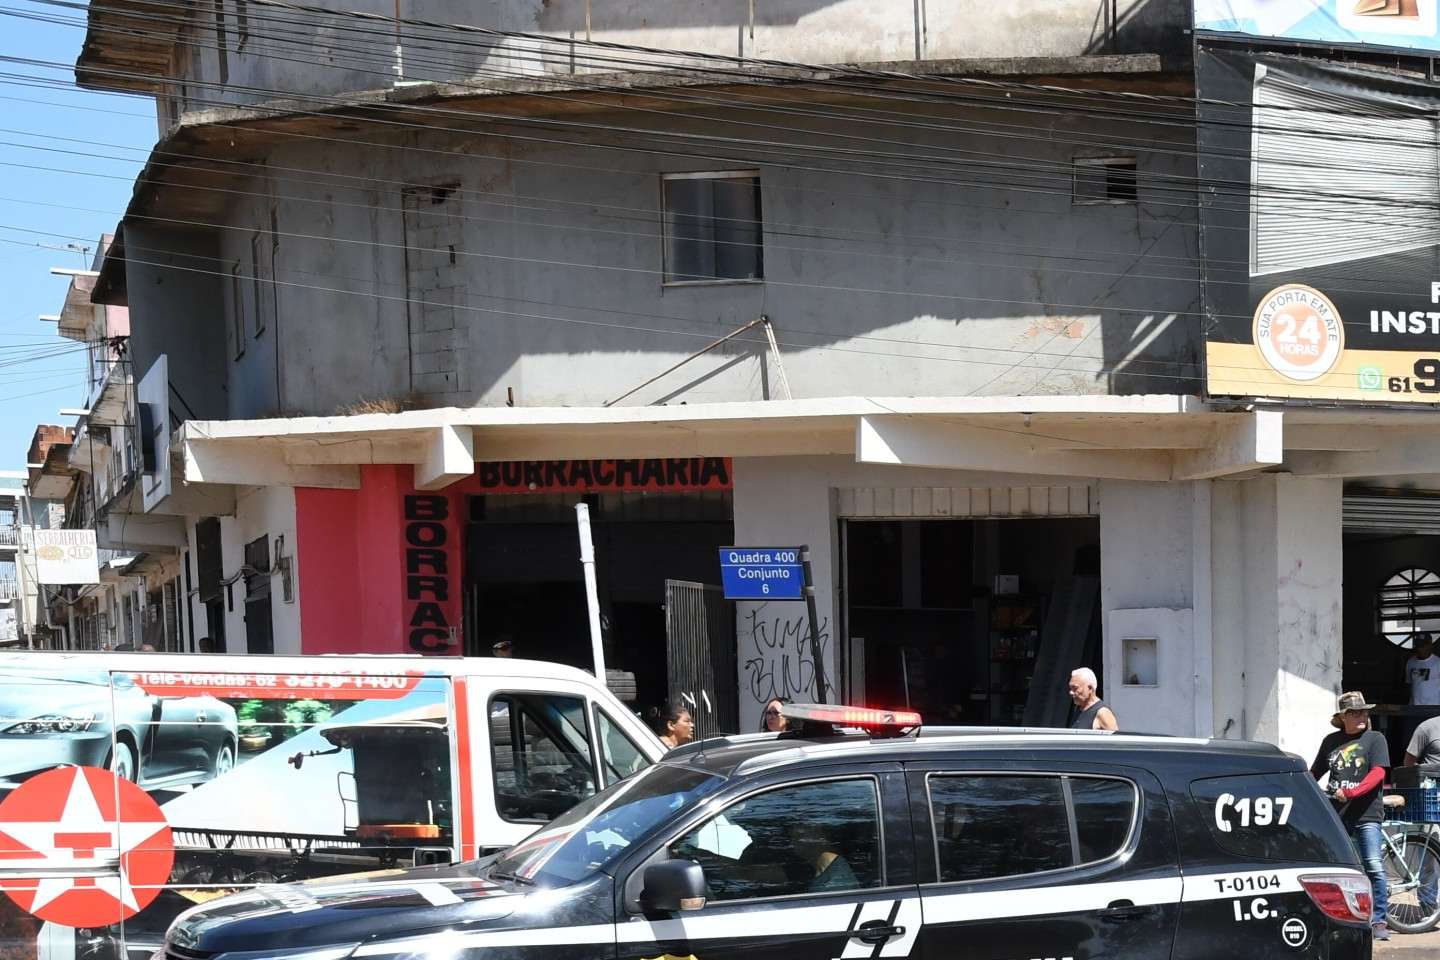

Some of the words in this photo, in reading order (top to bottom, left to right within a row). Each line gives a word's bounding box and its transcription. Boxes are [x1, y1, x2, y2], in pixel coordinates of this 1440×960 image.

[1260, 313, 1272, 338] SUA
[1269, 291, 1307, 312] PORTA
[1310, 297, 1328, 316] EM
[1275, 313, 1321, 345] 24
[1280, 343, 1319, 356] HORAS
[1388, 376, 1412, 394] 61
[729, 552, 771, 563] Quadra
[774, 552, 795, 563] 400
[738, 567, 790, 581] Conjunto
[762, 583, 770, 594] 6
[1234, 797, 1293, 827] 197
[1214, 874, 1281, 893] T-0104
[1233, 898, 1278, 921] I.C.
